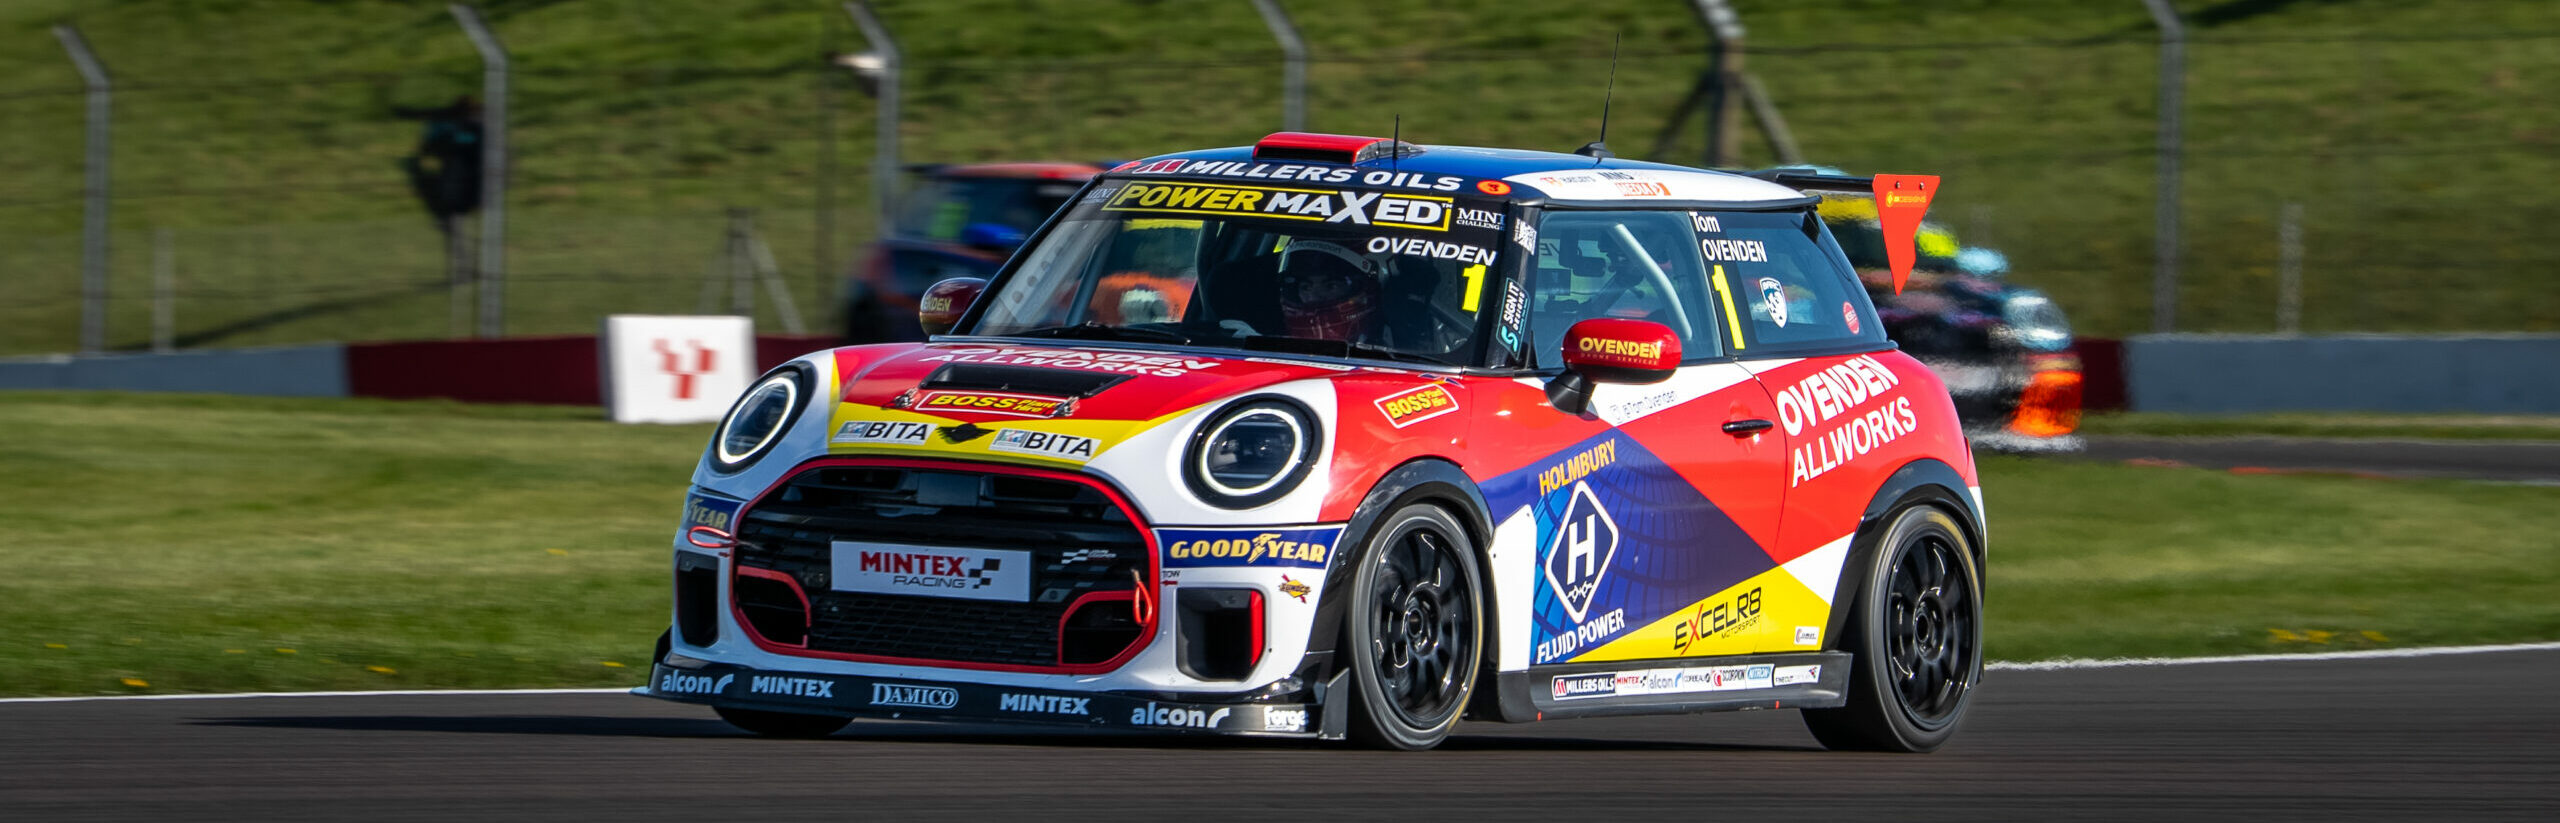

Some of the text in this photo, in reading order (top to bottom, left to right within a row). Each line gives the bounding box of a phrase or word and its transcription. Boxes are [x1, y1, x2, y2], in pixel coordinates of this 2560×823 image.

[1181, 161, 1464, 192] MILLERS OILS
[1113, 185, 1263, 211] POWER
[1457, 207, 1505, 226] MINI
[1689, 211, 1721, 233] Tom
[1368, 236, 1497, 267] OVENDEN
[1702, 239, 1768, 263] OVENDEN
[1462, 263, 1487, 313] 1
[1503, 294, 1518, 325] SIGN
[1513, 291, 1526, 331] DESIGNS
[1711, 265, 1745, 349] 1
[949, 348, 1221, 371] OVENDEN
[1580, 337, 1661, 359] OVENDEN
[920, 354, 1190, 378] ALLWORKS
[1617, 356, 1658, 366] SERVICES
[930, 395, 1018, 409] BOSS
[1386, 393, 1432, 419] BOSS
[1776, 354, 1899, 436] OVENDEN
[863, 421, 929, 441] BITA
[1792, 396, 1917, 488] ALLWORKS
[1024, 431, 1092, 457] BITA
[1538, 438, 1616, 496] HOLMBURY
[1566, 514, 1596, 585] H
[860, 550, 967, 578] MINTEX
[1162, 570, 1181, 578] TOW
[893, 574, 966, 589] RACING
[1674, 587, 1762, 656] EXCELR8
[1721, 614, 1761, 640] MOTORSPORT
[1536, 608, 1625, 664] FLUID POWER
[661, 669, 713, 694] alcon
[751, 675, 835, 699] MINTEX
[1566, 676, 1615, 695] MILLERS OILS
[1617, 675, 1640, 685] MINTEX
[1649, 674, 1674, 690] alcon
[1722, 668, 1745, 682] SCORPION
[870, 683, 956, 707] DAMICO
[1000, 693, 1091, 716] MINTEX
[1130, 701, 1207, 728] alcon
